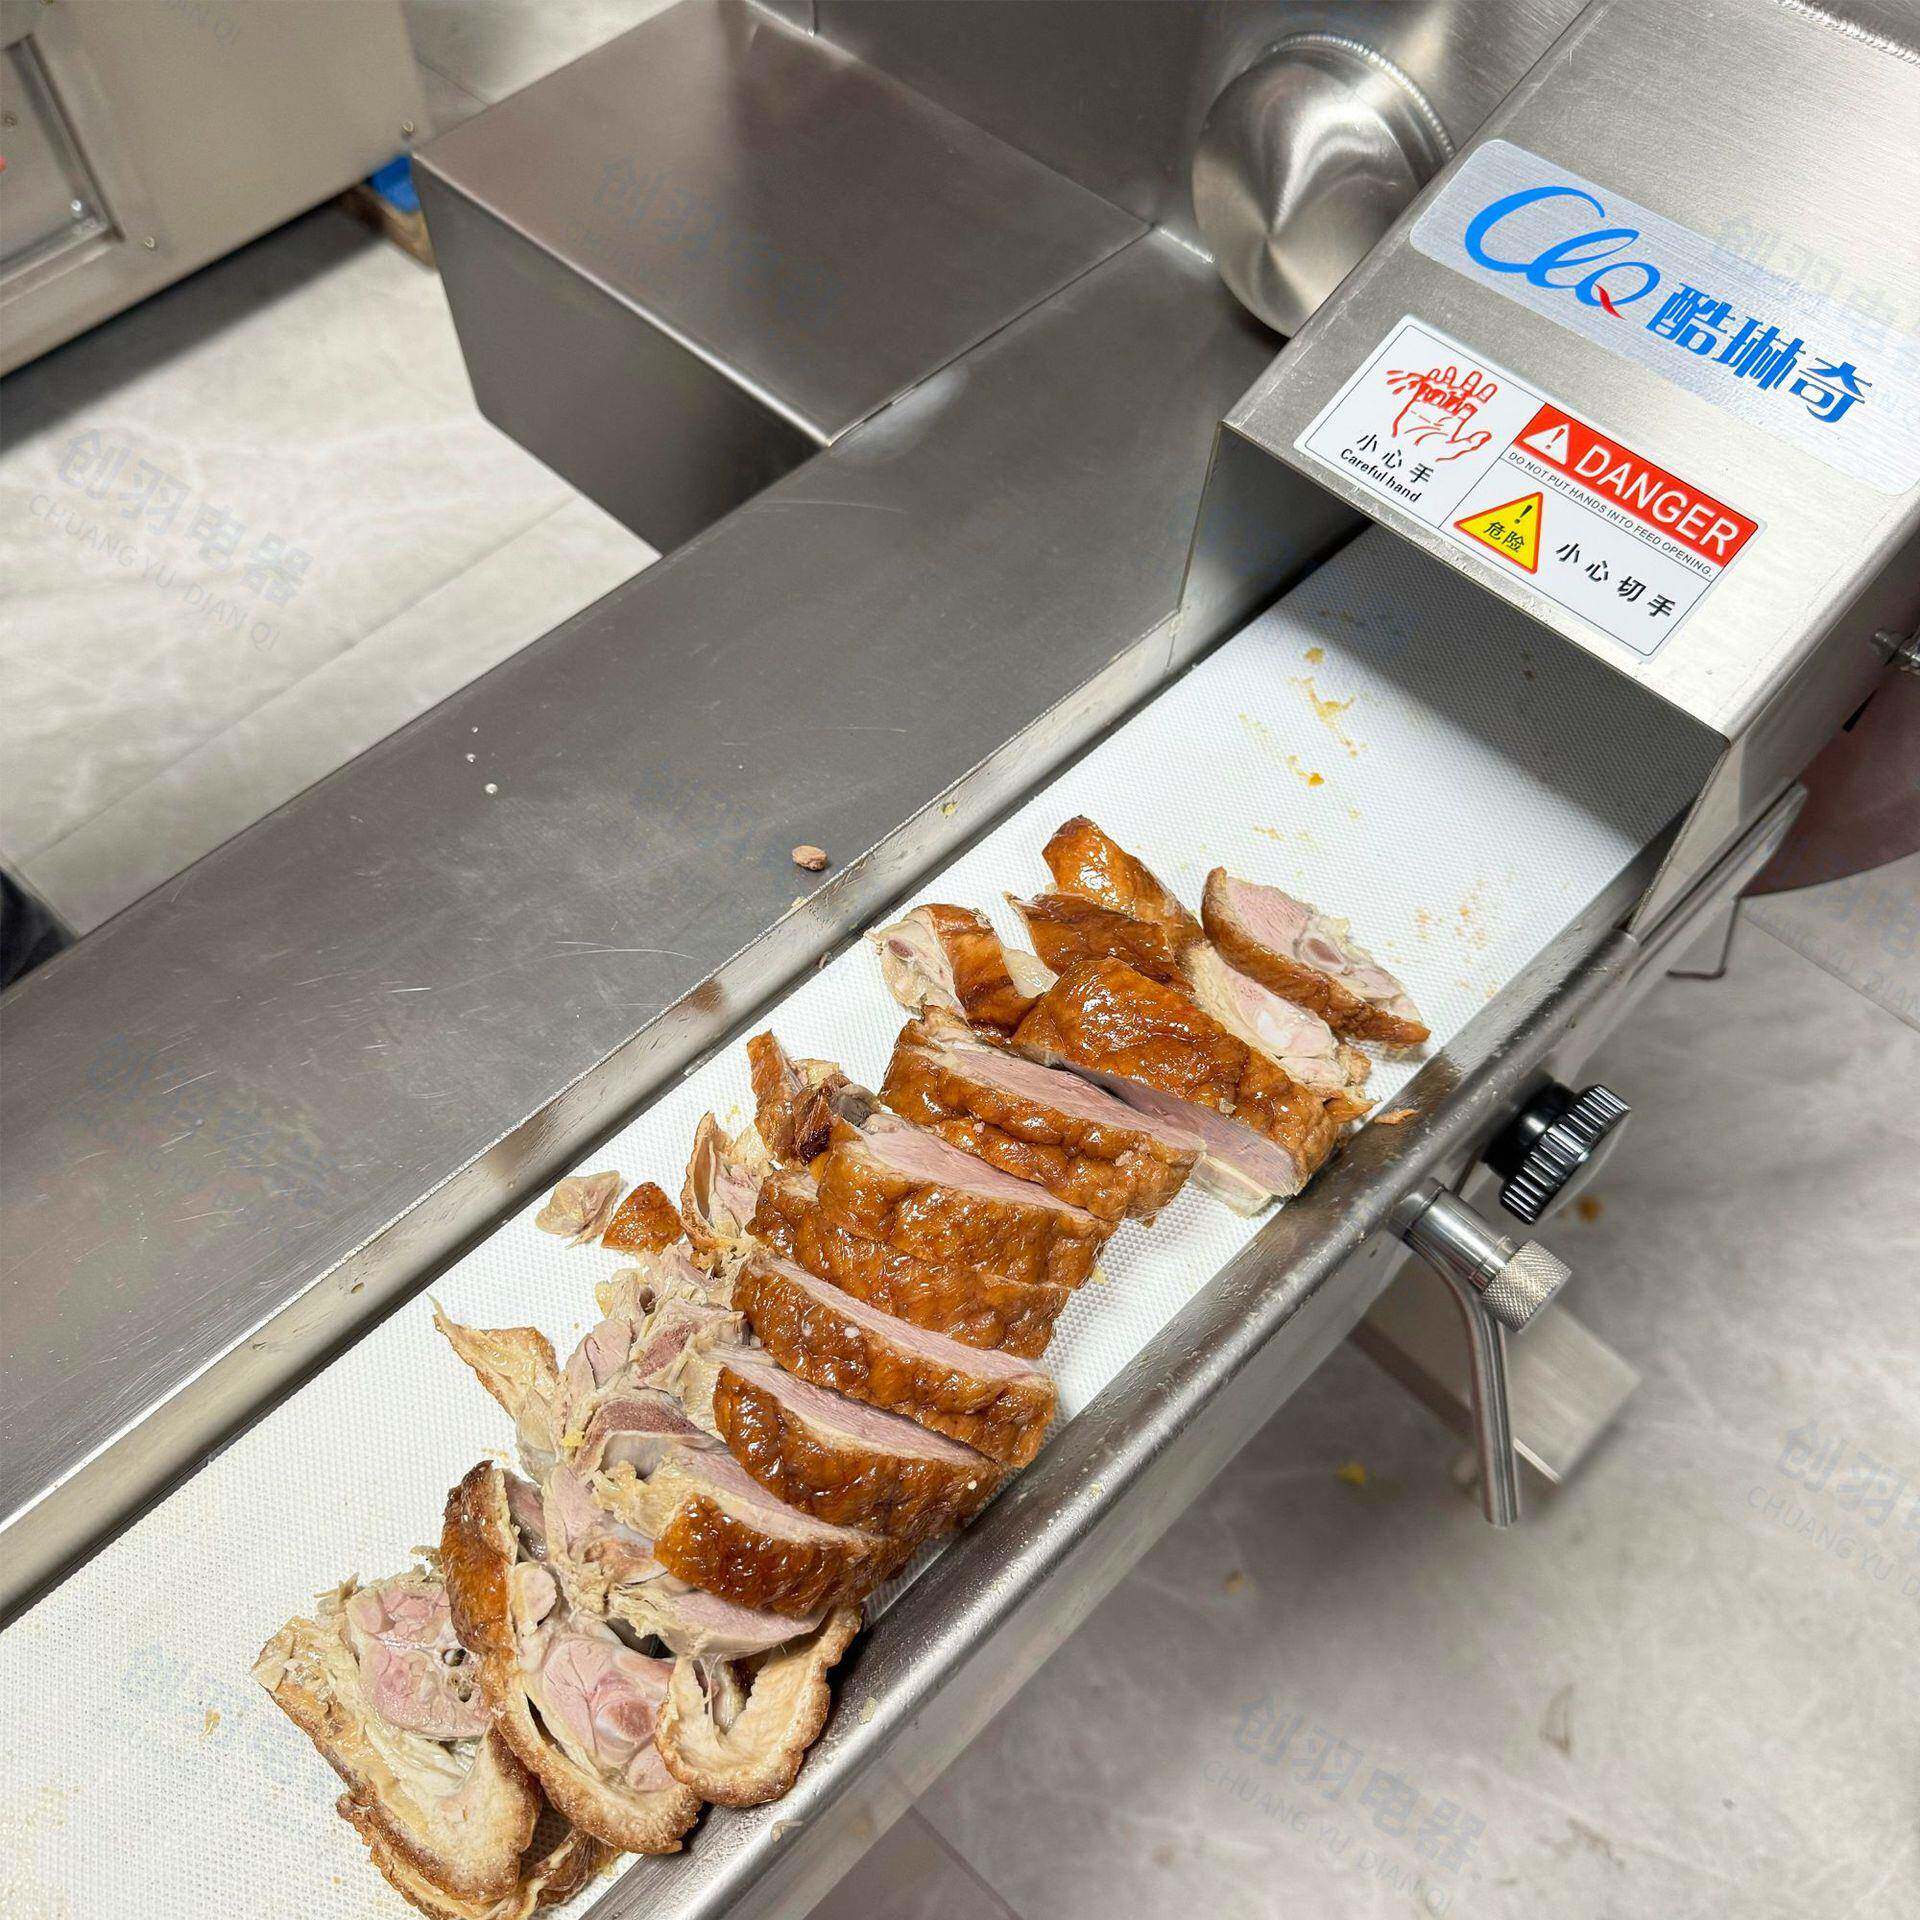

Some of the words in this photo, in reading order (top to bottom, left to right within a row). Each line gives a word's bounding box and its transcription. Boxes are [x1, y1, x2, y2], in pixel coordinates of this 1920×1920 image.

[1645, 281, 1872, 423] 酷琳奇
[1340, 448, 1388, 482] Careful
[1385, 475, 1422, 503] hand
[1356, 434, 1434, 483] 小心手
[1484, 521, 1525, 553] 危险
[1508, 451, 1525, 465] DO
[1525, 461, 1549, 478] NOT
[1547, 475, 1571, 490] PUT
[1570, 487, 1607, 513] HANDS
[1607, 509, 1634, 528] INTO
[1634, 525, 1661, 545] FEED
[1662, 542, 1713, 577] OPENING.
[1574, 445, 1738, 556] DANGER
[1556, 542, 1676, 617] 小心切手
